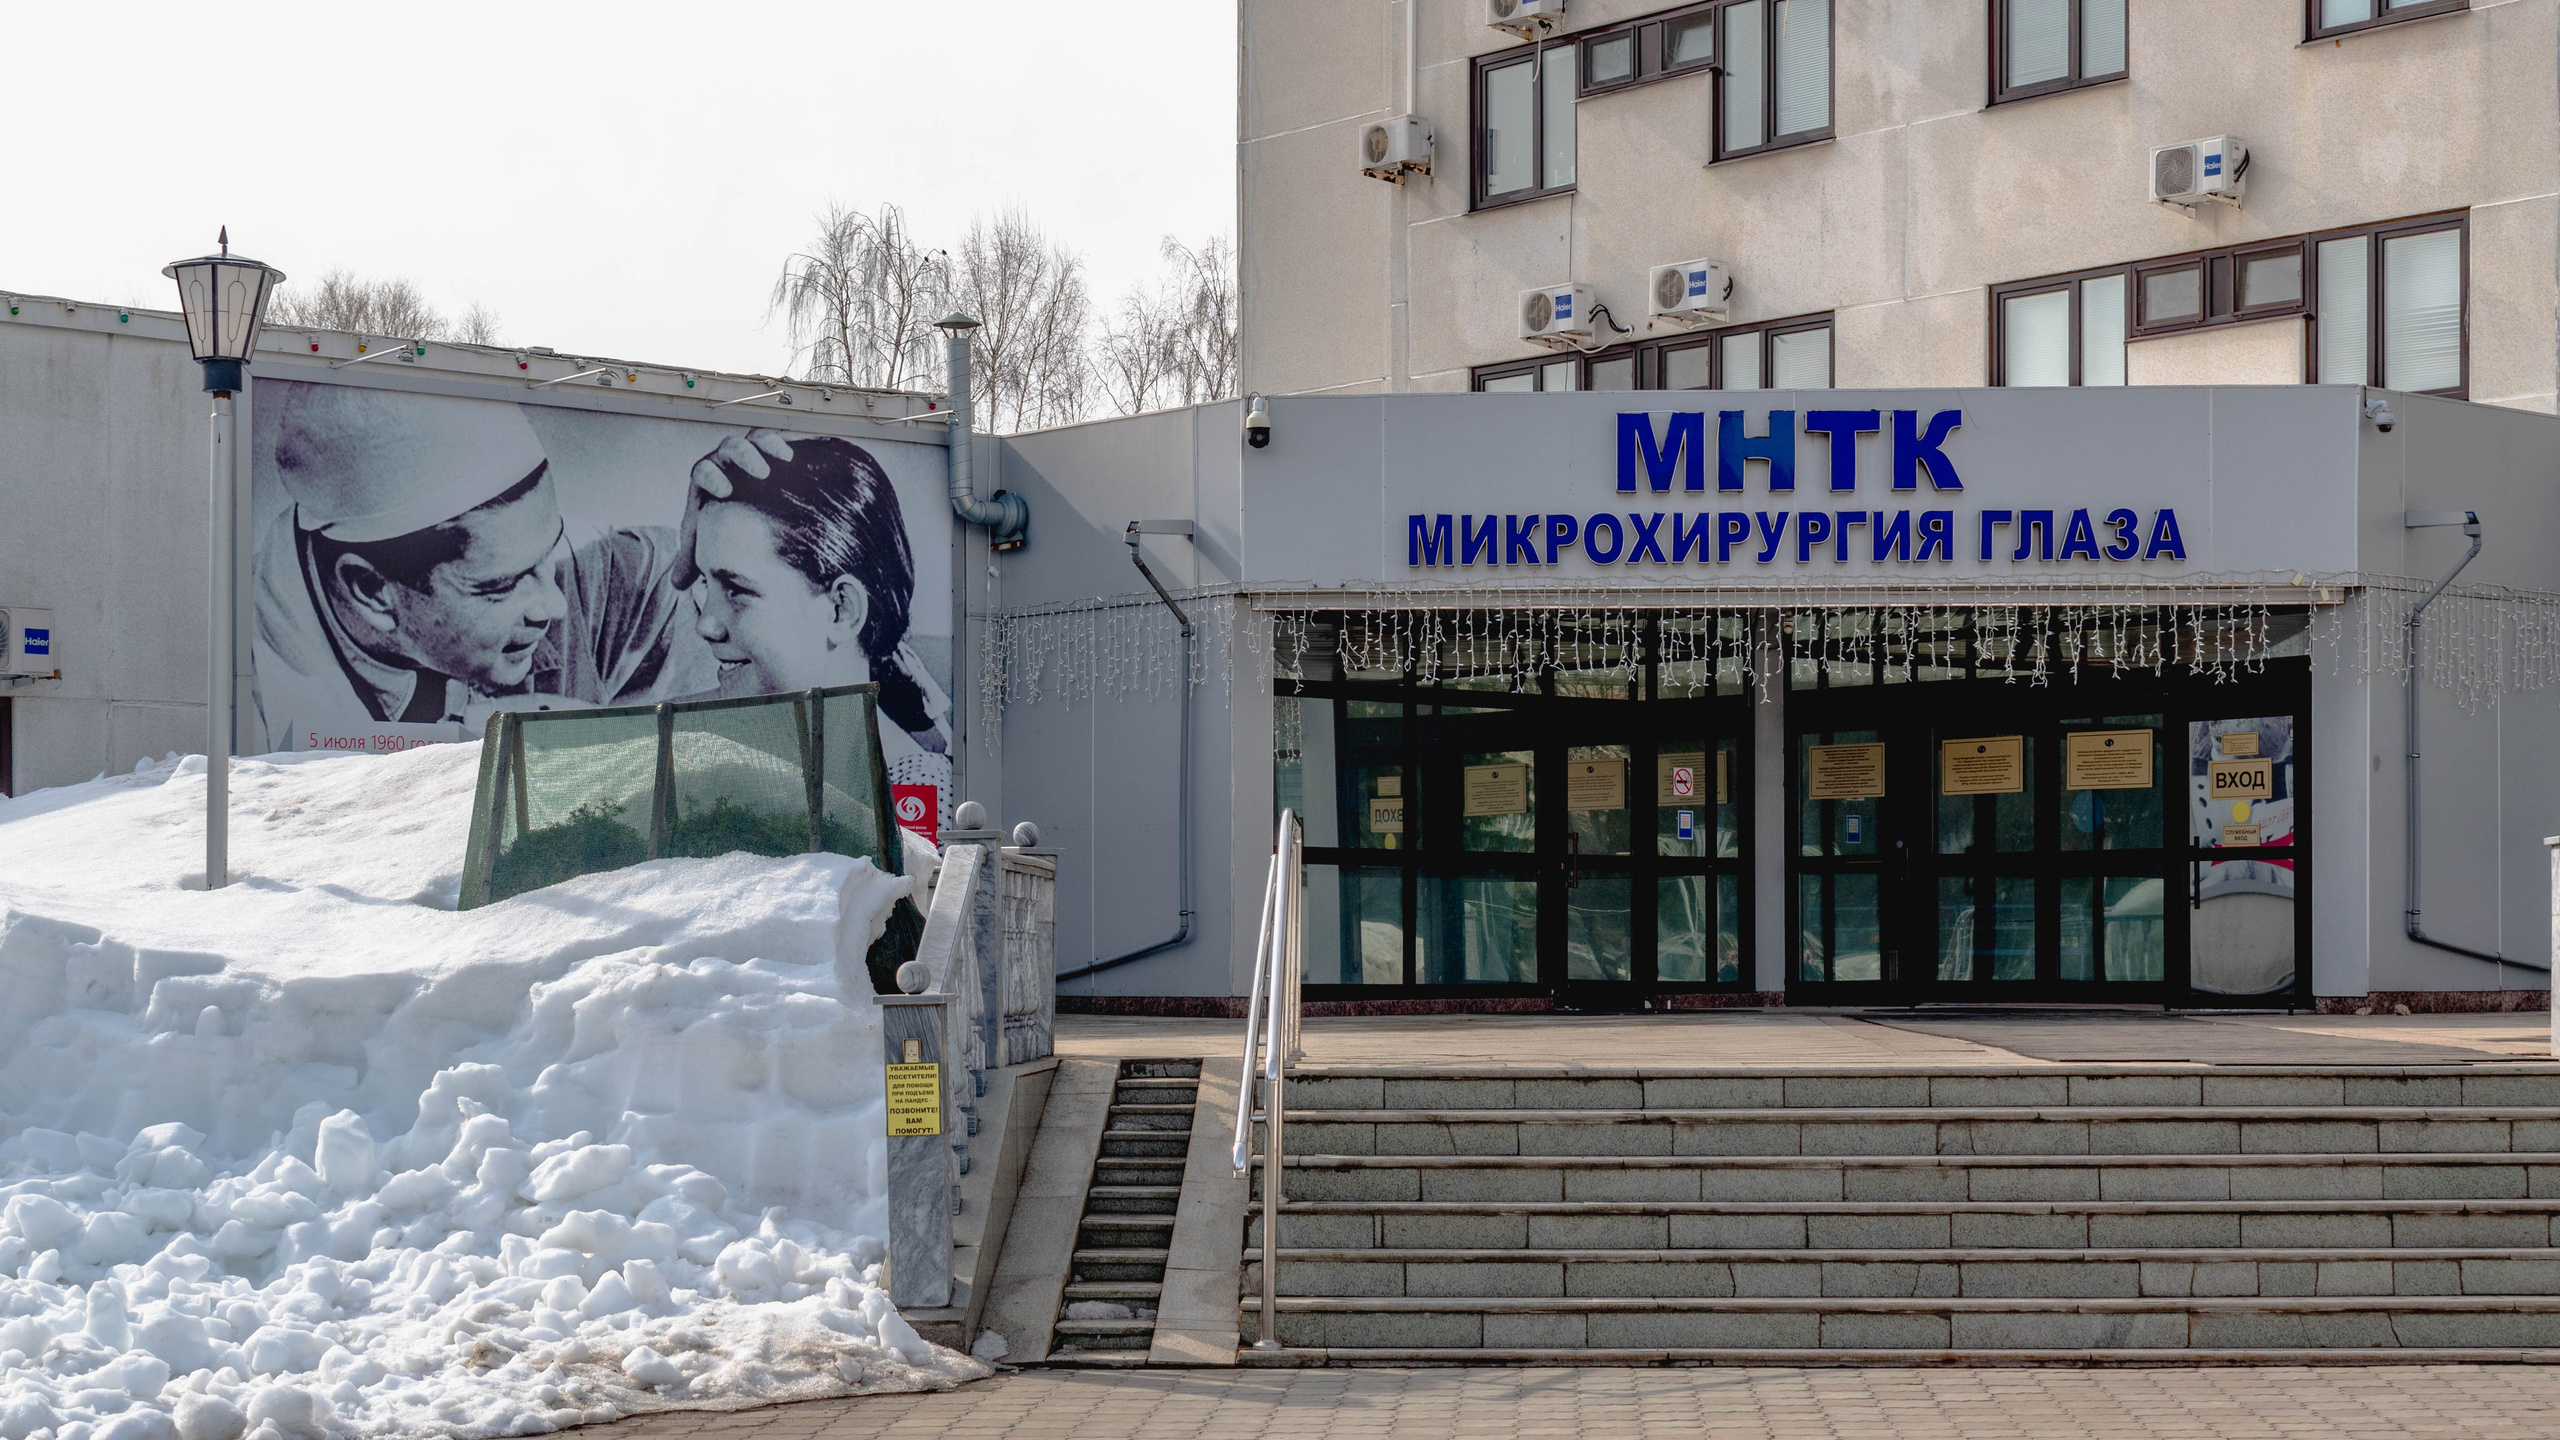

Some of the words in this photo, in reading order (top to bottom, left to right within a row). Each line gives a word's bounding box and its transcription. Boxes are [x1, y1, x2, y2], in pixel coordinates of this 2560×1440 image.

[2203, 161, 2221, 170] Haier
[1689, 279, 1706, 288] Haier
[1555, 302, 1572, 312] Haier
[1615, 409, 1964, 493] МНТК
[1408, 508, 1955, 567] МИКРОХИРУРГИЯ
[1978, 508, 2188, 562] ГЛАЗА
[25, 637, 49, 647] Haier
[309, 732, 318, 748] 5
[323, 736, 365, 749] июля
[371, 734, 405, 750] 1960
[2216, 771, 2266, 791] ВХОД
[2225, 828, 2257, 836] СЛУЖЕБНЫЙ
